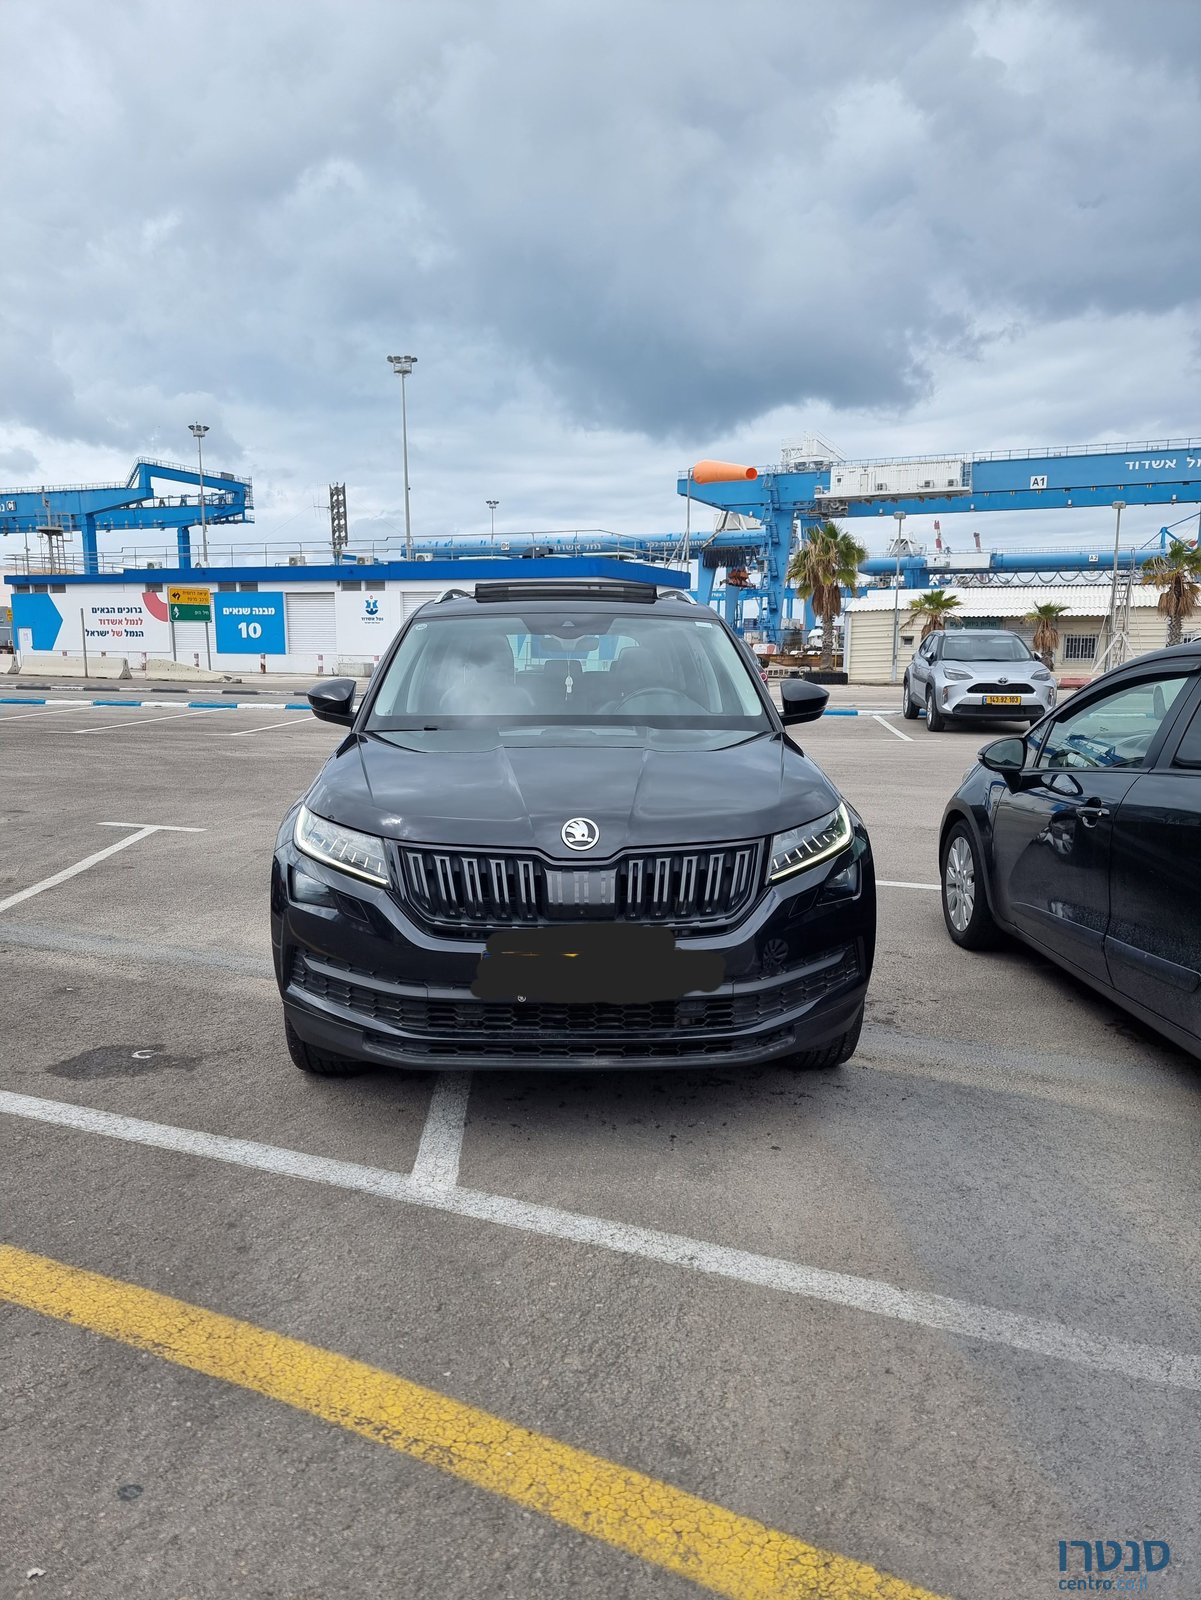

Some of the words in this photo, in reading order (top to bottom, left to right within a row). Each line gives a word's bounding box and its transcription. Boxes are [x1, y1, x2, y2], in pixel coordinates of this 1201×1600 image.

[1124, 459, 1177, 470] אשדוד
[1031, 477, 1046, 487] A1
[91, 606, 116, 614] הבאים
[117, 606, 143, 614] ברוכים
[222, 607, 251, 616] שנאים
[252, 607, 276, 616] מבנה
[98, 618, 123, 626] אשדוד
[124, 617, 144, 626] לנמל
[85, 628, 110, 637] ישראל
[110, 628, 123, 638] של
[124, 628, 144, 638] הנמל
[237, 621, 262, 639] 10
